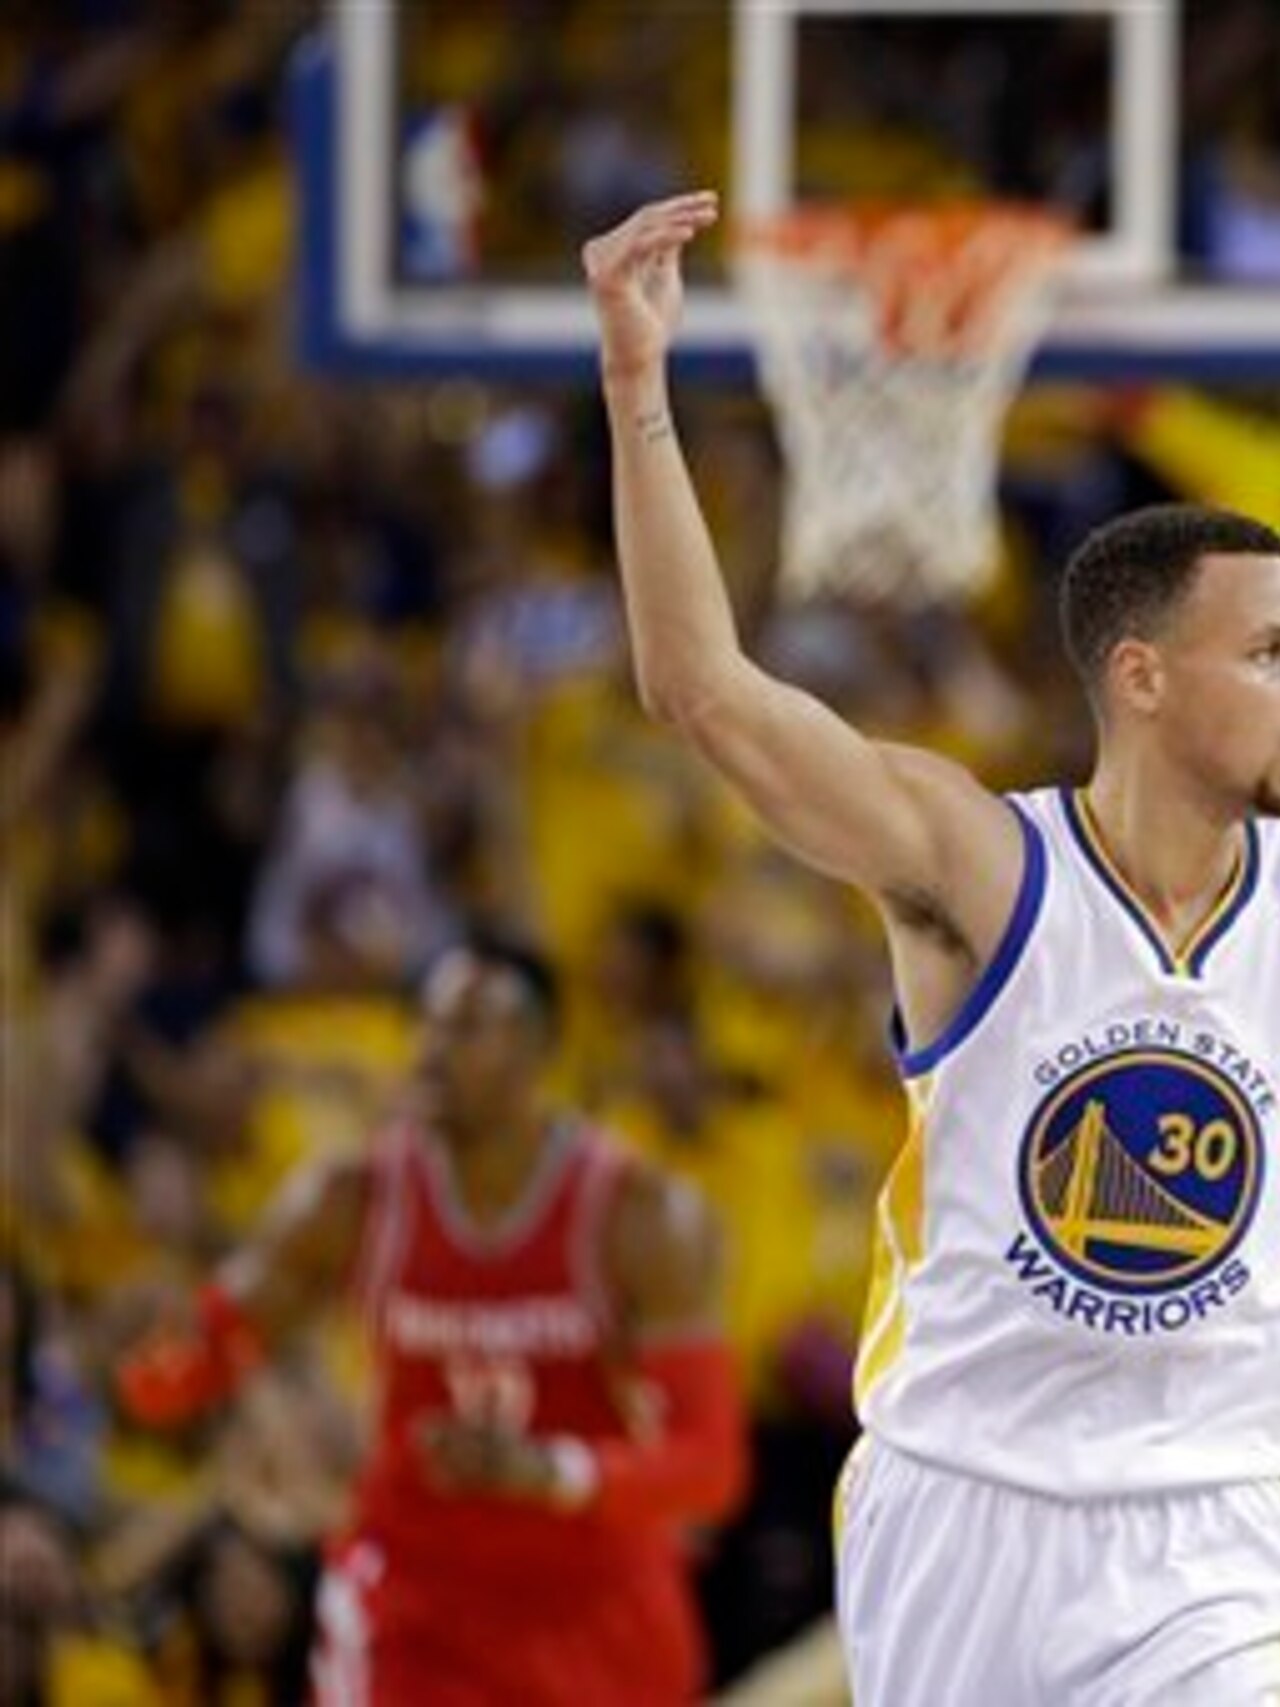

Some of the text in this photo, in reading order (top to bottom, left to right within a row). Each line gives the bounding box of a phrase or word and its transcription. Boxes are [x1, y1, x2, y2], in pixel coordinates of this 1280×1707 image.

[1034, 1020, 1277, 1115] GOLDEN STATE
[1149, 1113, 1237, 1181] 30
[1005, 1232, 1250, 1335] WARRIORS
